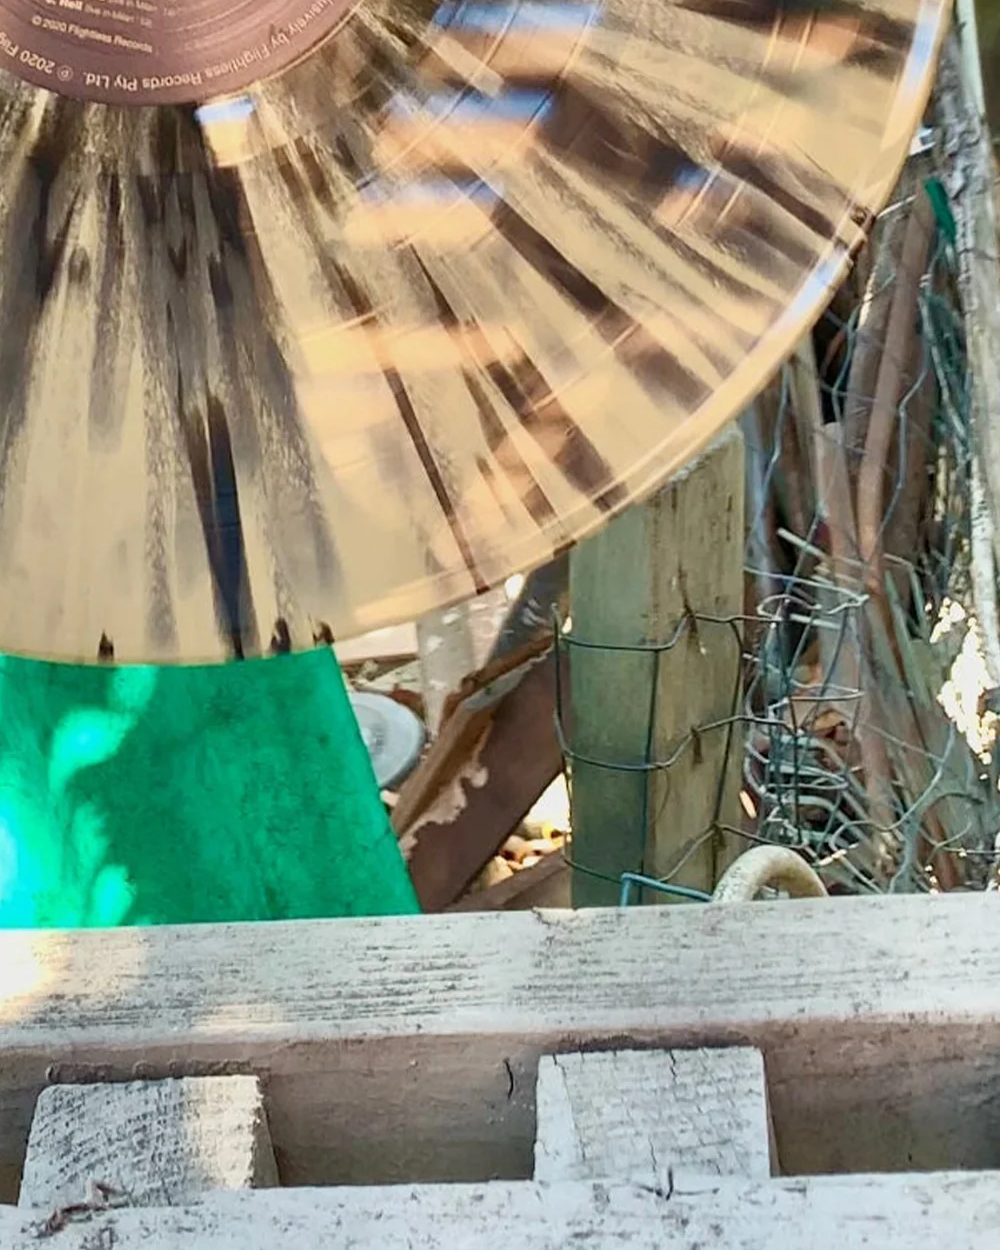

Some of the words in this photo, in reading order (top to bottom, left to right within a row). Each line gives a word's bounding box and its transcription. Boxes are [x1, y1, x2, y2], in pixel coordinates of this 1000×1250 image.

[271, 31, 291, 49] by
[20, 50, 56, 74] 2020
[206, 44, 270, 77] Flightless
[83, 71, 110, 90] Ltd.
[114, 74, 138, 91] Pty
[143, 72, 202, 90] Records
